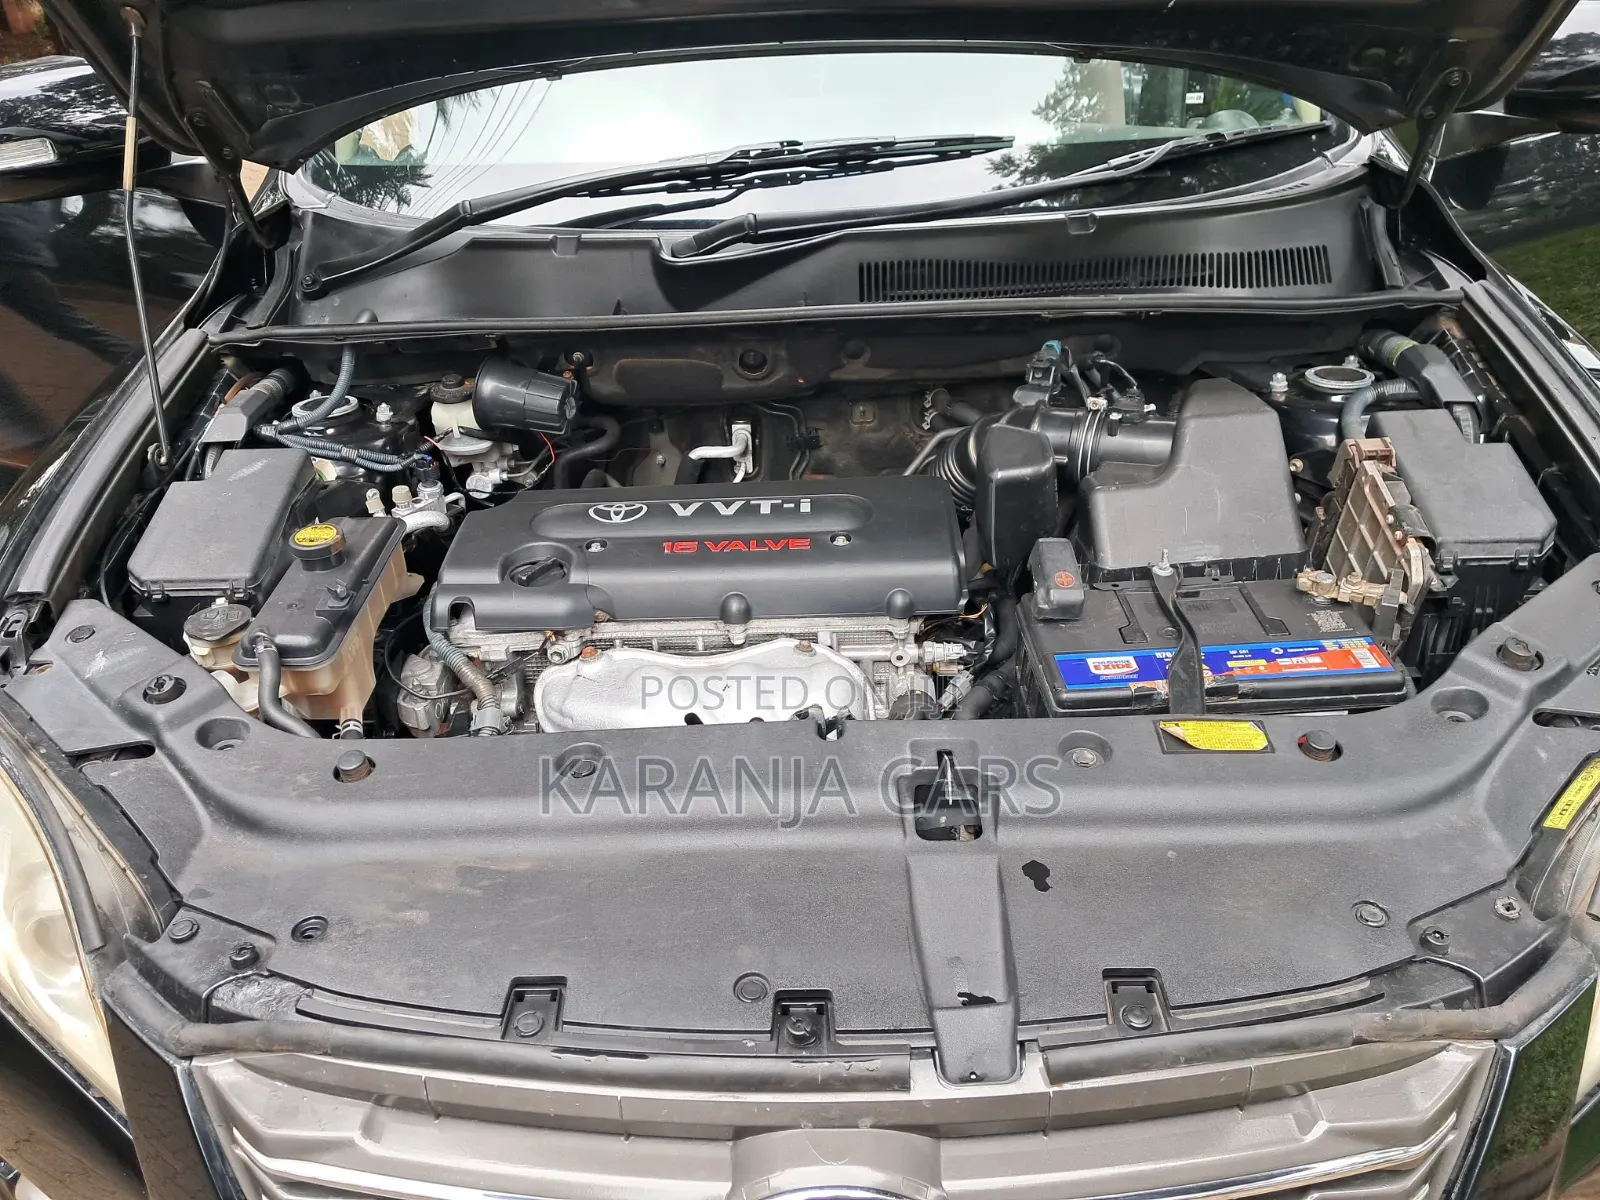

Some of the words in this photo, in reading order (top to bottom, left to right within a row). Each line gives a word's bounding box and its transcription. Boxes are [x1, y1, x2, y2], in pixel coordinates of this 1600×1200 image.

[669, 498, 811, 517] VVT-i
[663, 541, 698, 553] 16
[704, 538, 811, 552] VALVE
[1093, 663, 1134, 671] EXIDE
